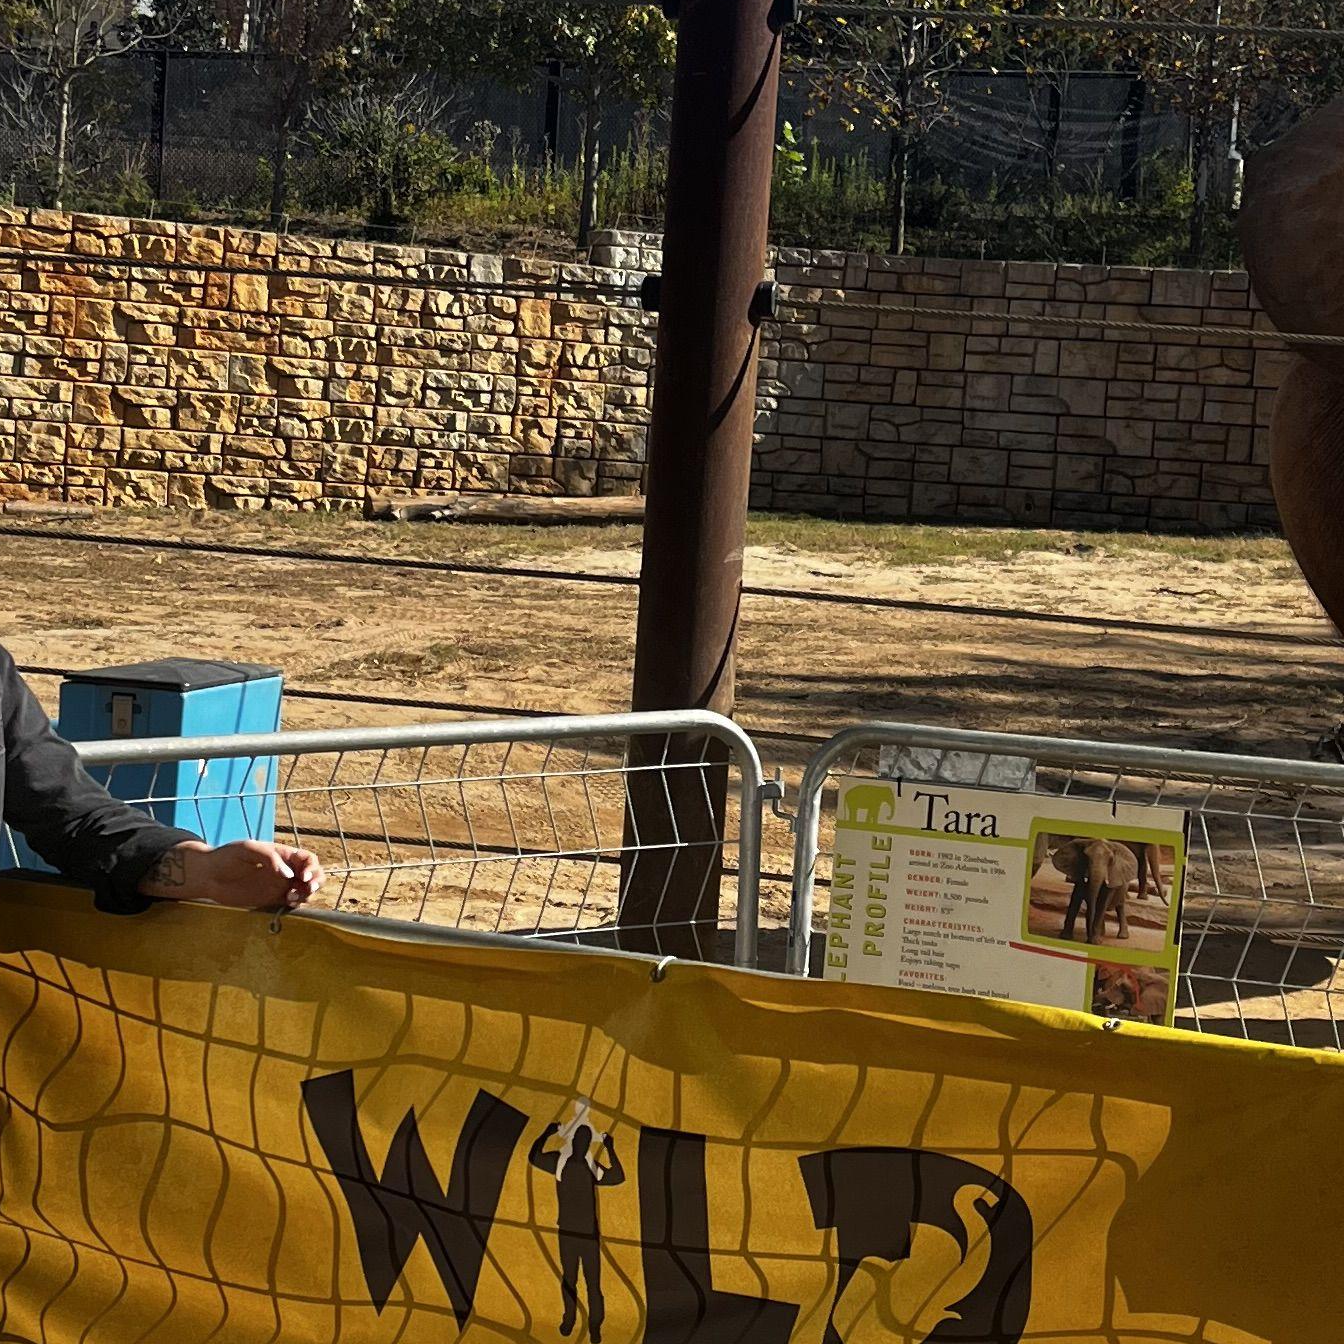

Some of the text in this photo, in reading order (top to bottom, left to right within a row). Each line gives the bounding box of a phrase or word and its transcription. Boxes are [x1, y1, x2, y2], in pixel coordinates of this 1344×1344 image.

[914, 791, 1000, 838] Tara
[940, 862, 954, 870] Zoo
[908, 874, 944, 884] GENDER:
[863, 836, 892, 956] PROFILE
[906, 888, 942, 898] WEIGHT:
[827, 852, 857, 983] EPHANT
[904, 918, 984, 932] CHARACTERISTICS:
